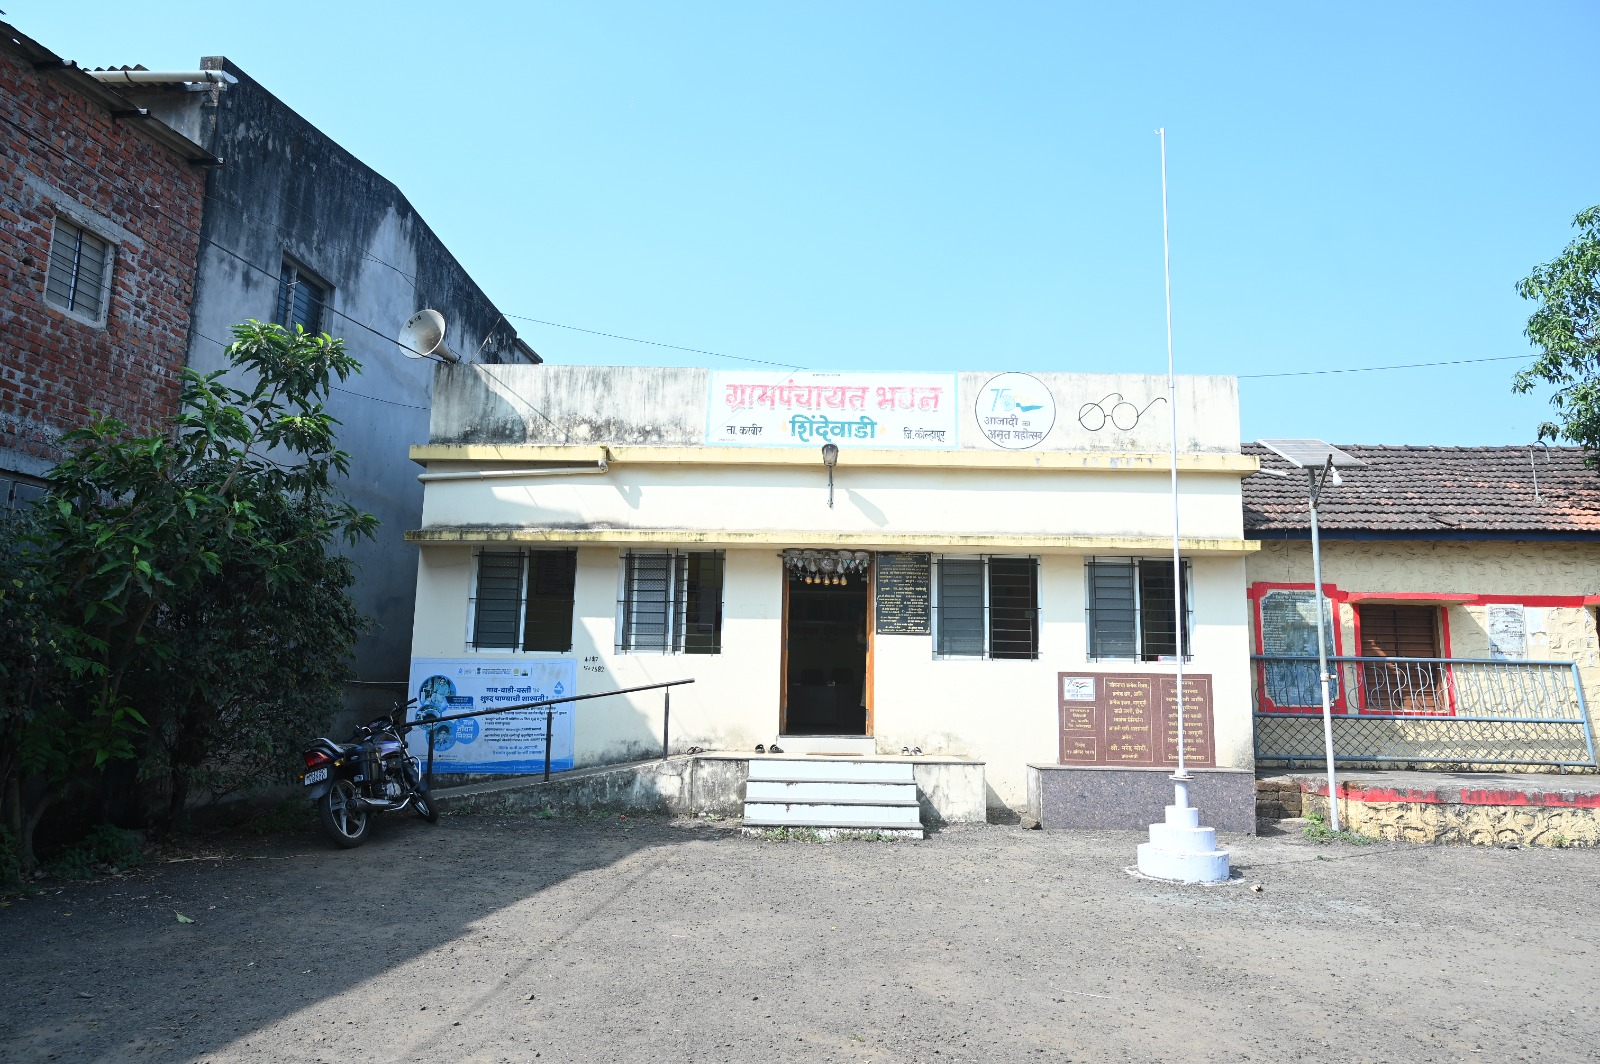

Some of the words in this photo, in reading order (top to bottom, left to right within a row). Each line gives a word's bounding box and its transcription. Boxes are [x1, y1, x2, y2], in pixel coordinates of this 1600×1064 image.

[725, 379, 870, 412] ग्रामपंचायत
[876, 385, 944, 412] भवन
[789, 414, 877, 443] शिंदेवाडी
[984, 413, 1019, 427] आजादी
[739, 422, 763, 436] करवीर
[987, 429, 1011, 444] अमृत
[1012, 427, 1043, 441] महोत्सव
